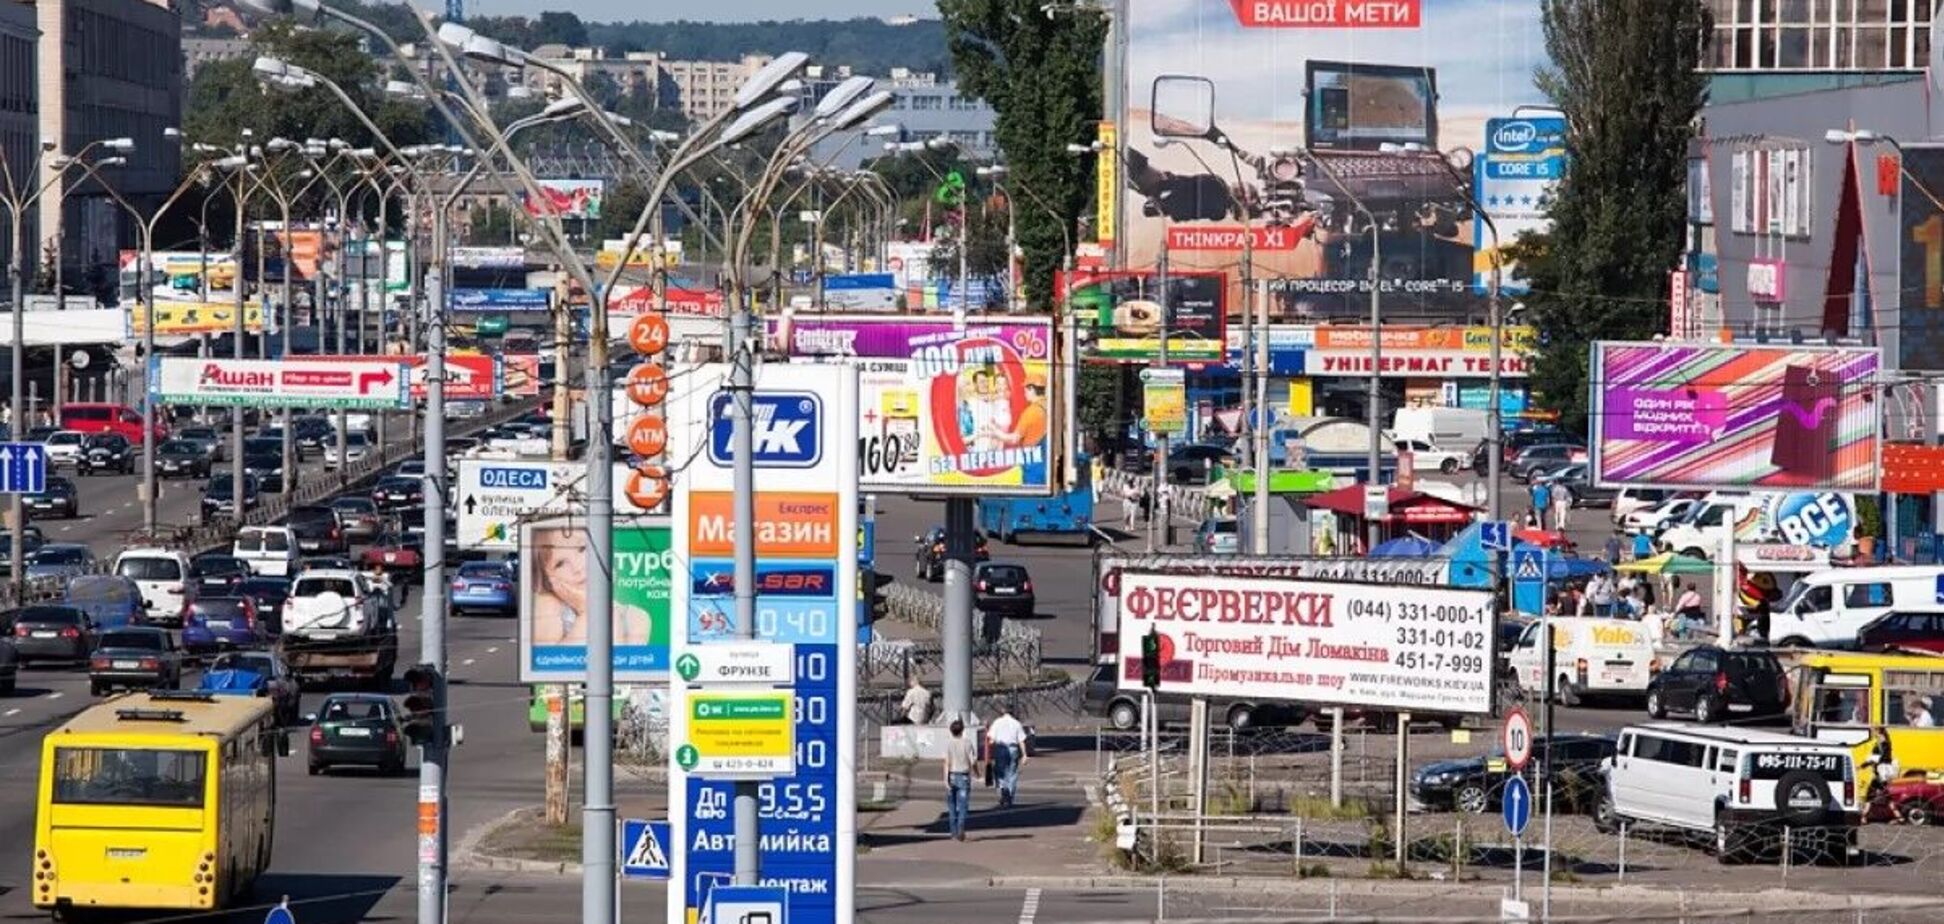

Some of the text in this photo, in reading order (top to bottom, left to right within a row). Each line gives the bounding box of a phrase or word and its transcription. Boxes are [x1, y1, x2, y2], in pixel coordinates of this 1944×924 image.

[1254, 0, 1409, 22] ВАШОЇ МЕТИ
[1499, 163, 1532, 175] CORE
[1264, 231, 1284, 247] X1
[1290, 281, 1355, 293] ПРОЦЕСОР
[637, 323, 664, 344] 24
[911, 344, 958, 379] 100
[200, 363, 274, 385] Ашан
[632, 378, 664, 395] WC
[1633, 398, 1671, 409] ОДИН
[634, 427, 664, 442] ATM
[483, 470, 543, 486] ОДЕСА
[1781, 492, 1847, 545] ВСЕ
[1126, 586, 1483, 627] ФЕЄРВЕРКИ (044) 331-000-1
[1396, 627, 1484, 649] 331-01-02
[1183, 632, 1390, 663] Торговий Дім Ломакіна
[717, 665, 772, 677] ФРУНЗЕ
[1395, 651, 1483, 674] 451-7-999
[1316, 674, 1346, 690] шоу
[1510, 731, 1524, 749] 10
